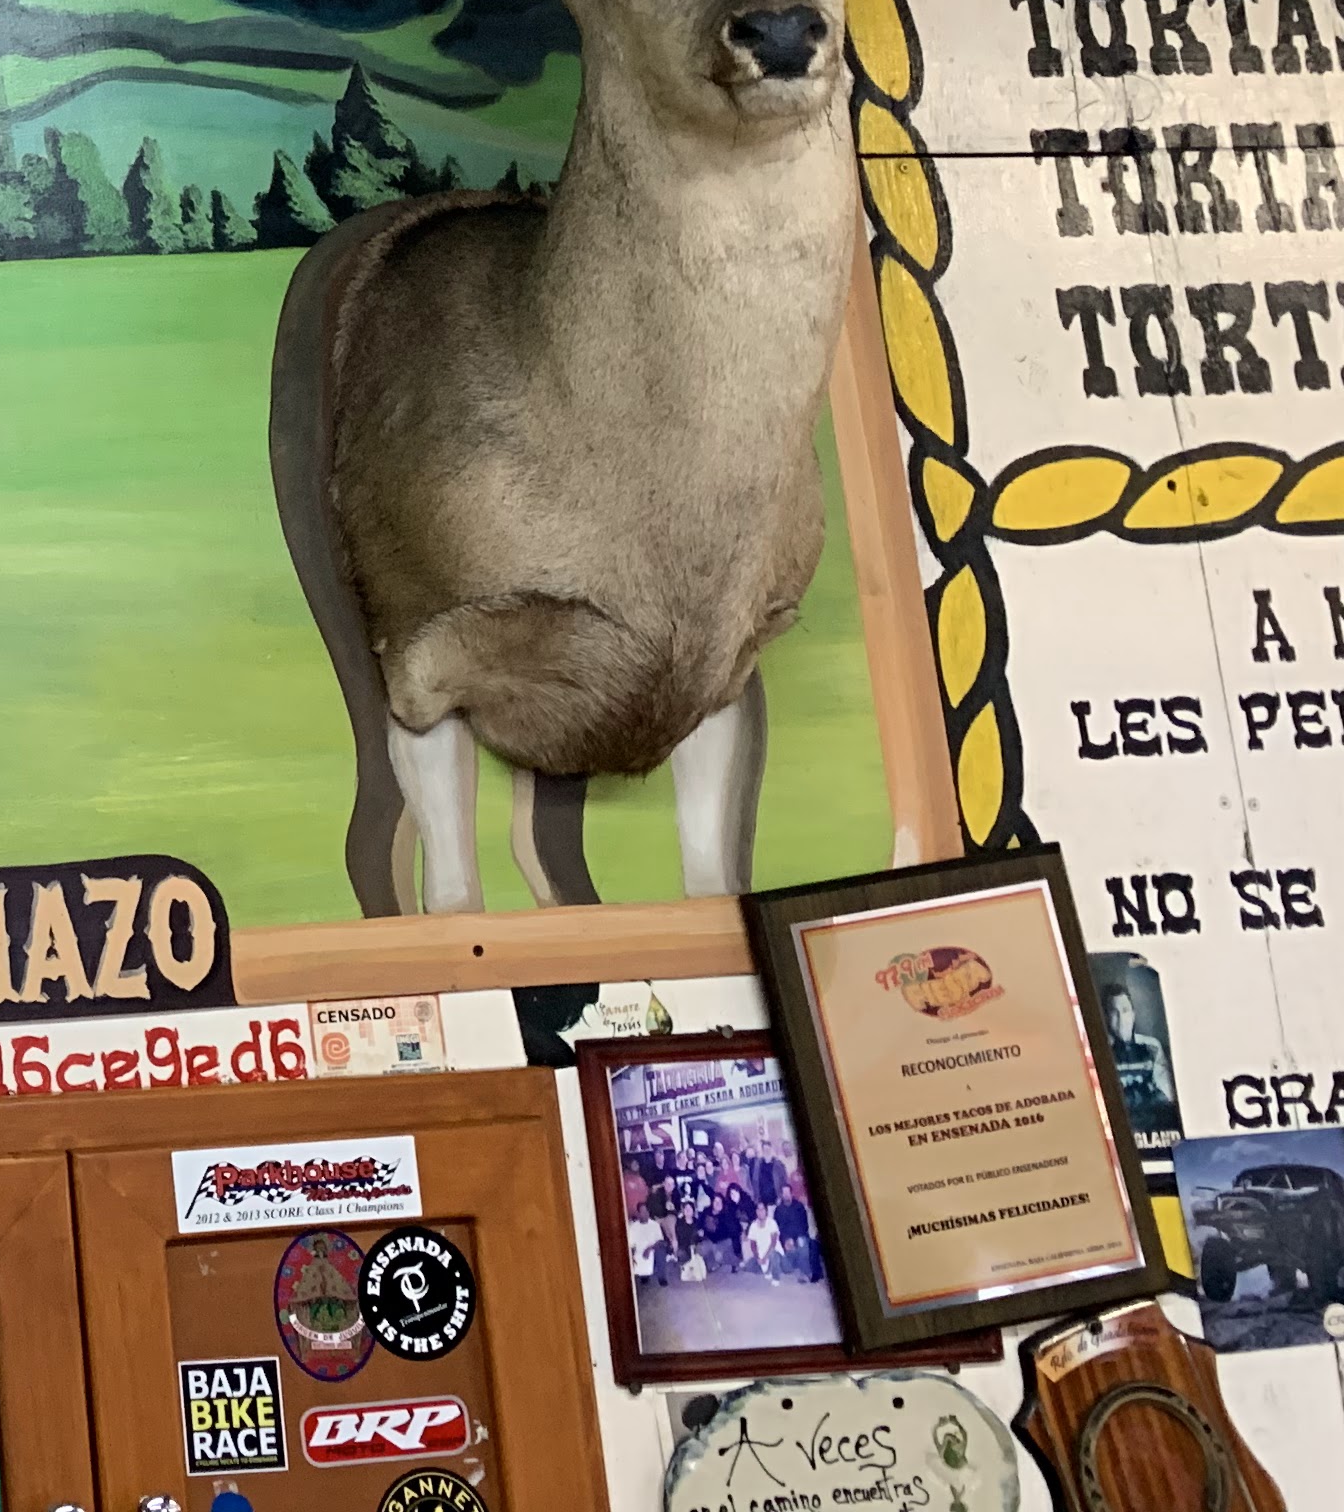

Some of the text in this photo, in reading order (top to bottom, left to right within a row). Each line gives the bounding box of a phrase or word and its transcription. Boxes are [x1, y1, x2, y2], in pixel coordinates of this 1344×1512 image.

[1056, 281, 1344, 398] TORT
[1251, 588, 1297, 663] A
[1071, 689, 1344, 759] LES PE
[1106, 870, 1325, 936] NO SE
[316, 1006, 396, 1025] CENSADO
[902, 1045, 1021, 1077] RECONOCIMIENTO
[869, 1090, 1075, 1137] LOS MEJORES TACOS DE ADOBADA
[908, 1112, 1045, 1147] EN ENSENADA 2016
[214, 1158, 376, 1198] Parkhouse
[906, 1179, 946, 1194] VOTADOS
[947, 1175, 964, 1187] POR
[195, 1212, 220, 1225] 2012
[223, 1210, 233, 1223] &
[236, 1209, 261, 1222] 2013
[263, 1206, 304, 1220] SCORE
[307, 1205, 335, 1217] Class
[346, 1201, 405, 1218] Champions
[998, 1192, 1091, 1220] FELICIDADES!
[367, 1236, 453, 1297] ENSENADA
[376, 1285, 470, 1353] IS THE SHIT
[188, 1367, 272, 1399] BAJA
[191, 1397, 275, 1431] BIKE
[309, 1405, 461, 1450] BRP
[194, 1427, 278, 1460] RACE
[718, 1412, 897, 1487] A Veces
[388, 1477, 481, 1512] GANNE
[832, 1469, 930, 1506] encuentras
